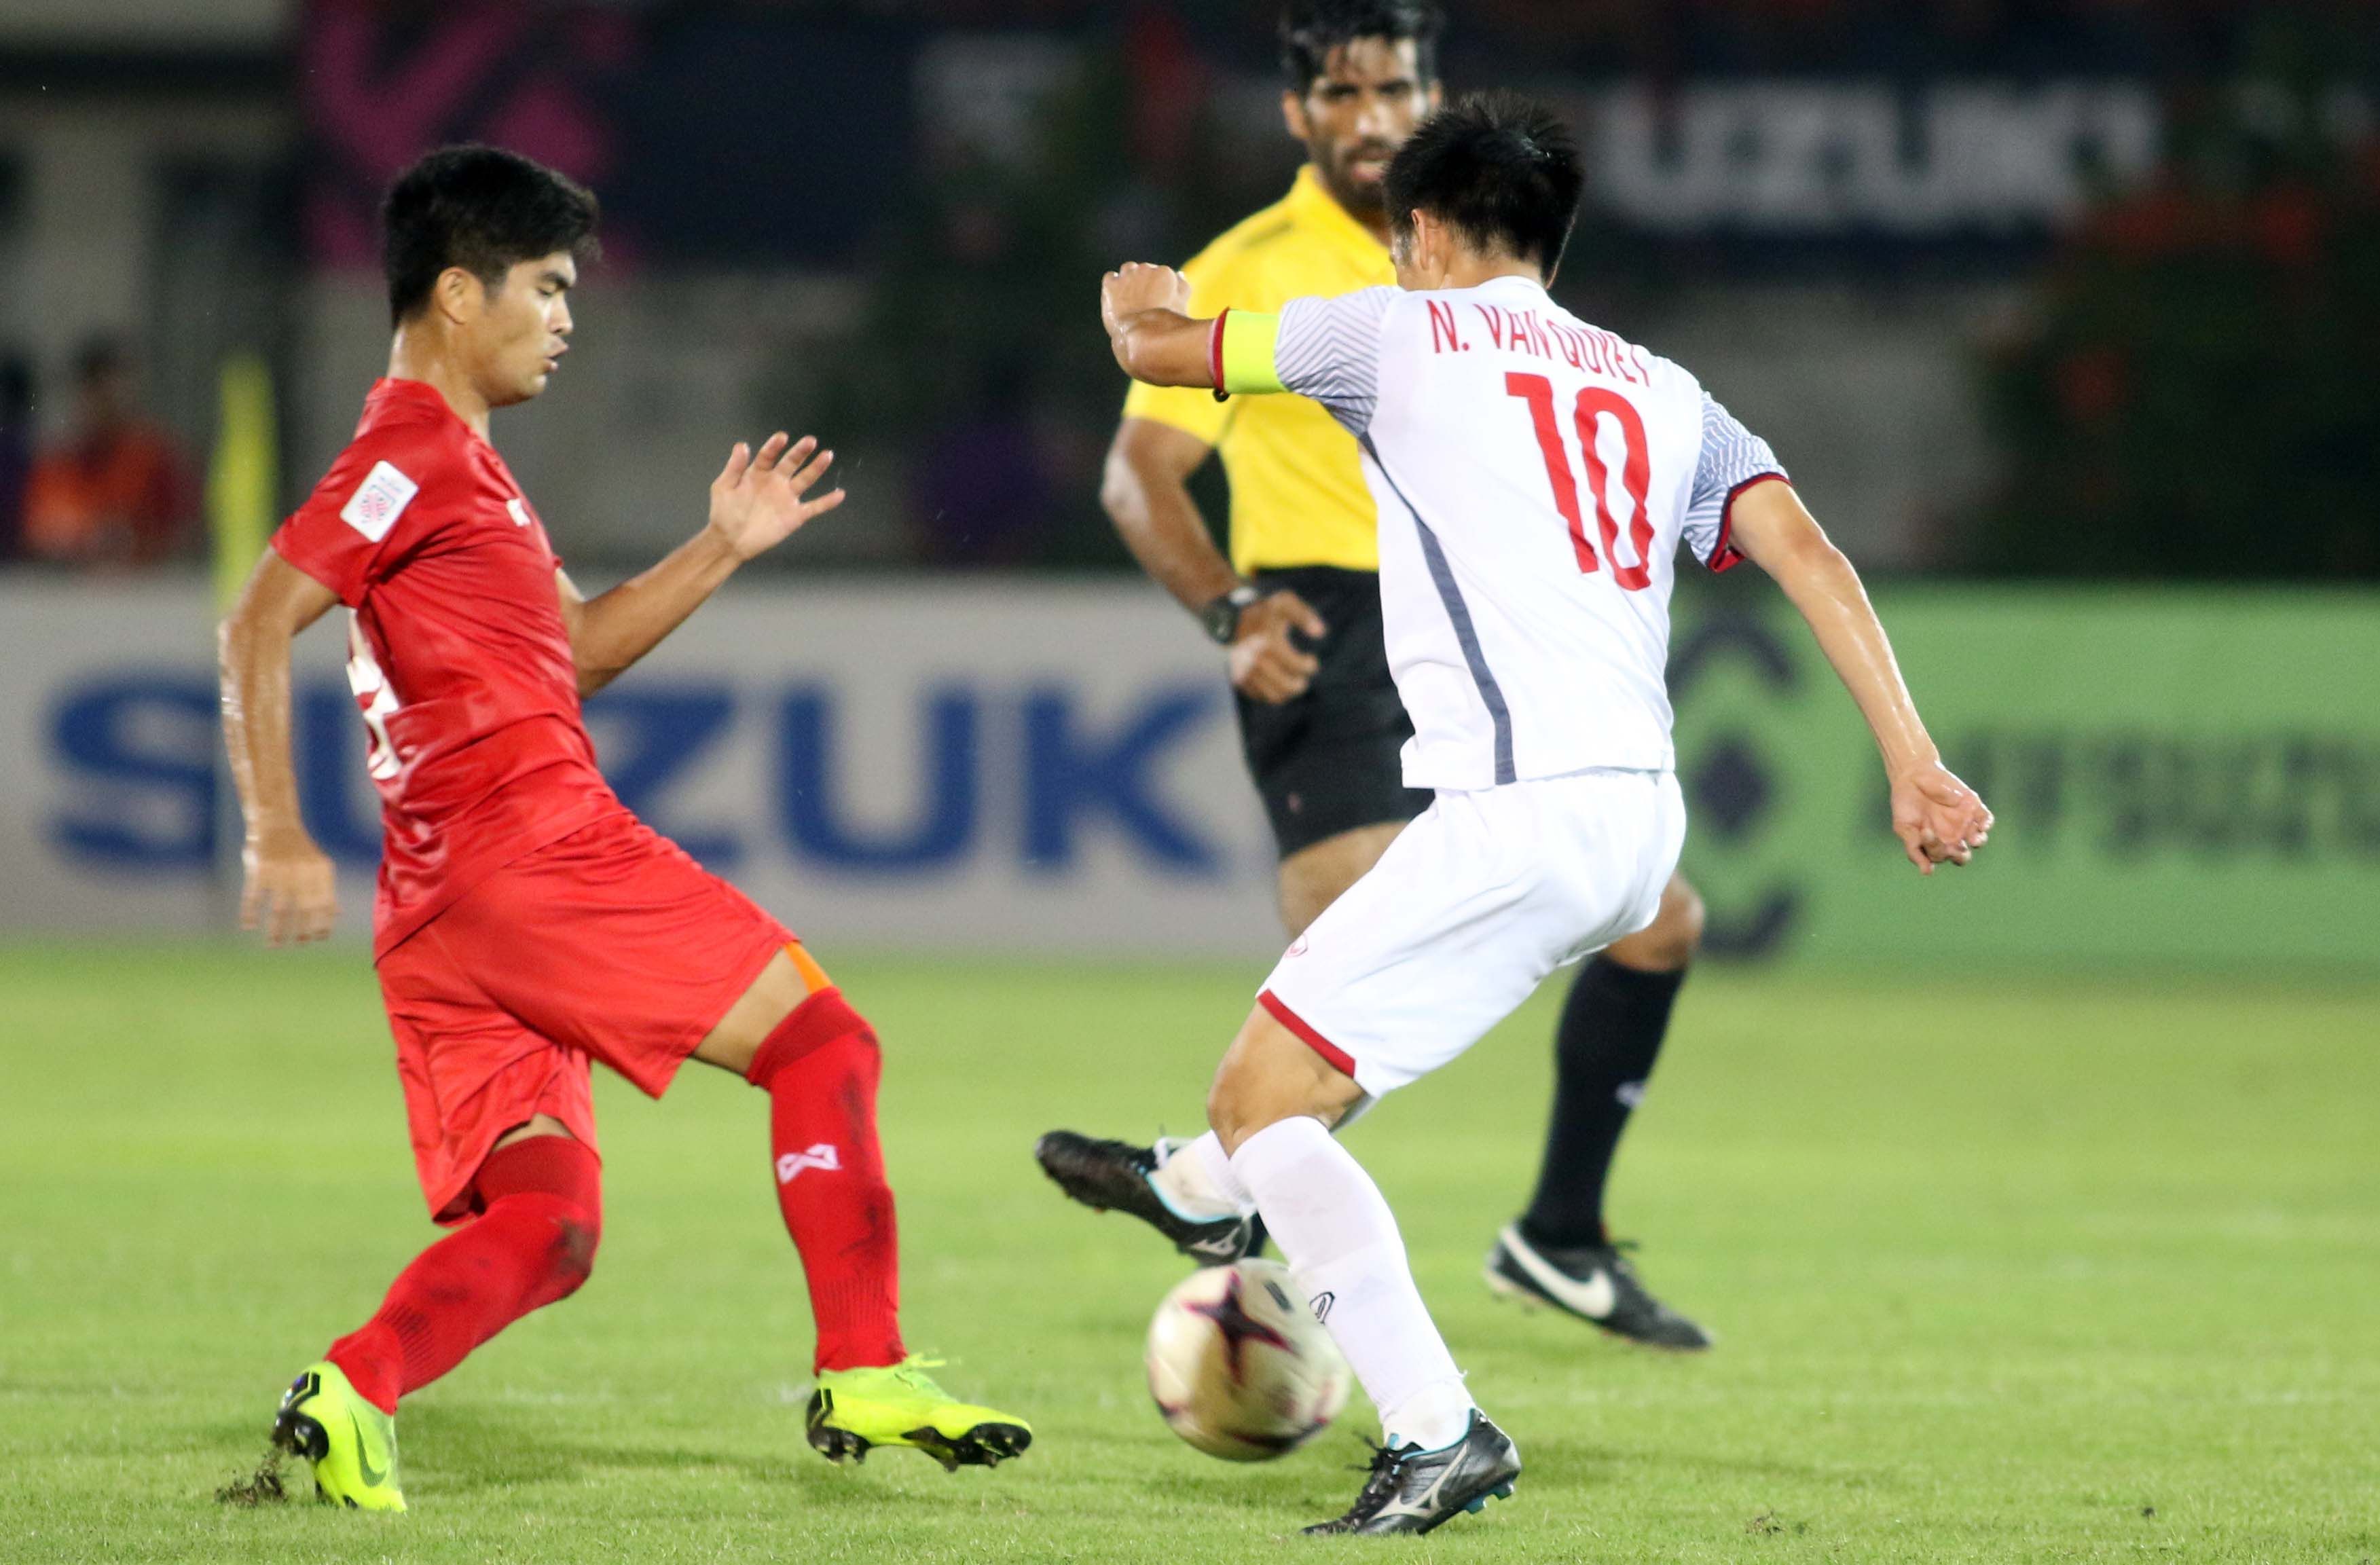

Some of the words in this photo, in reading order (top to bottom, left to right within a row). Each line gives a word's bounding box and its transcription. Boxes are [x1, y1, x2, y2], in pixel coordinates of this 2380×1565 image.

[1426, 299, 1470, 354] N.
[1472, 303, 1553, 361] VAN
[1505, 371, 1655, 591] 10
